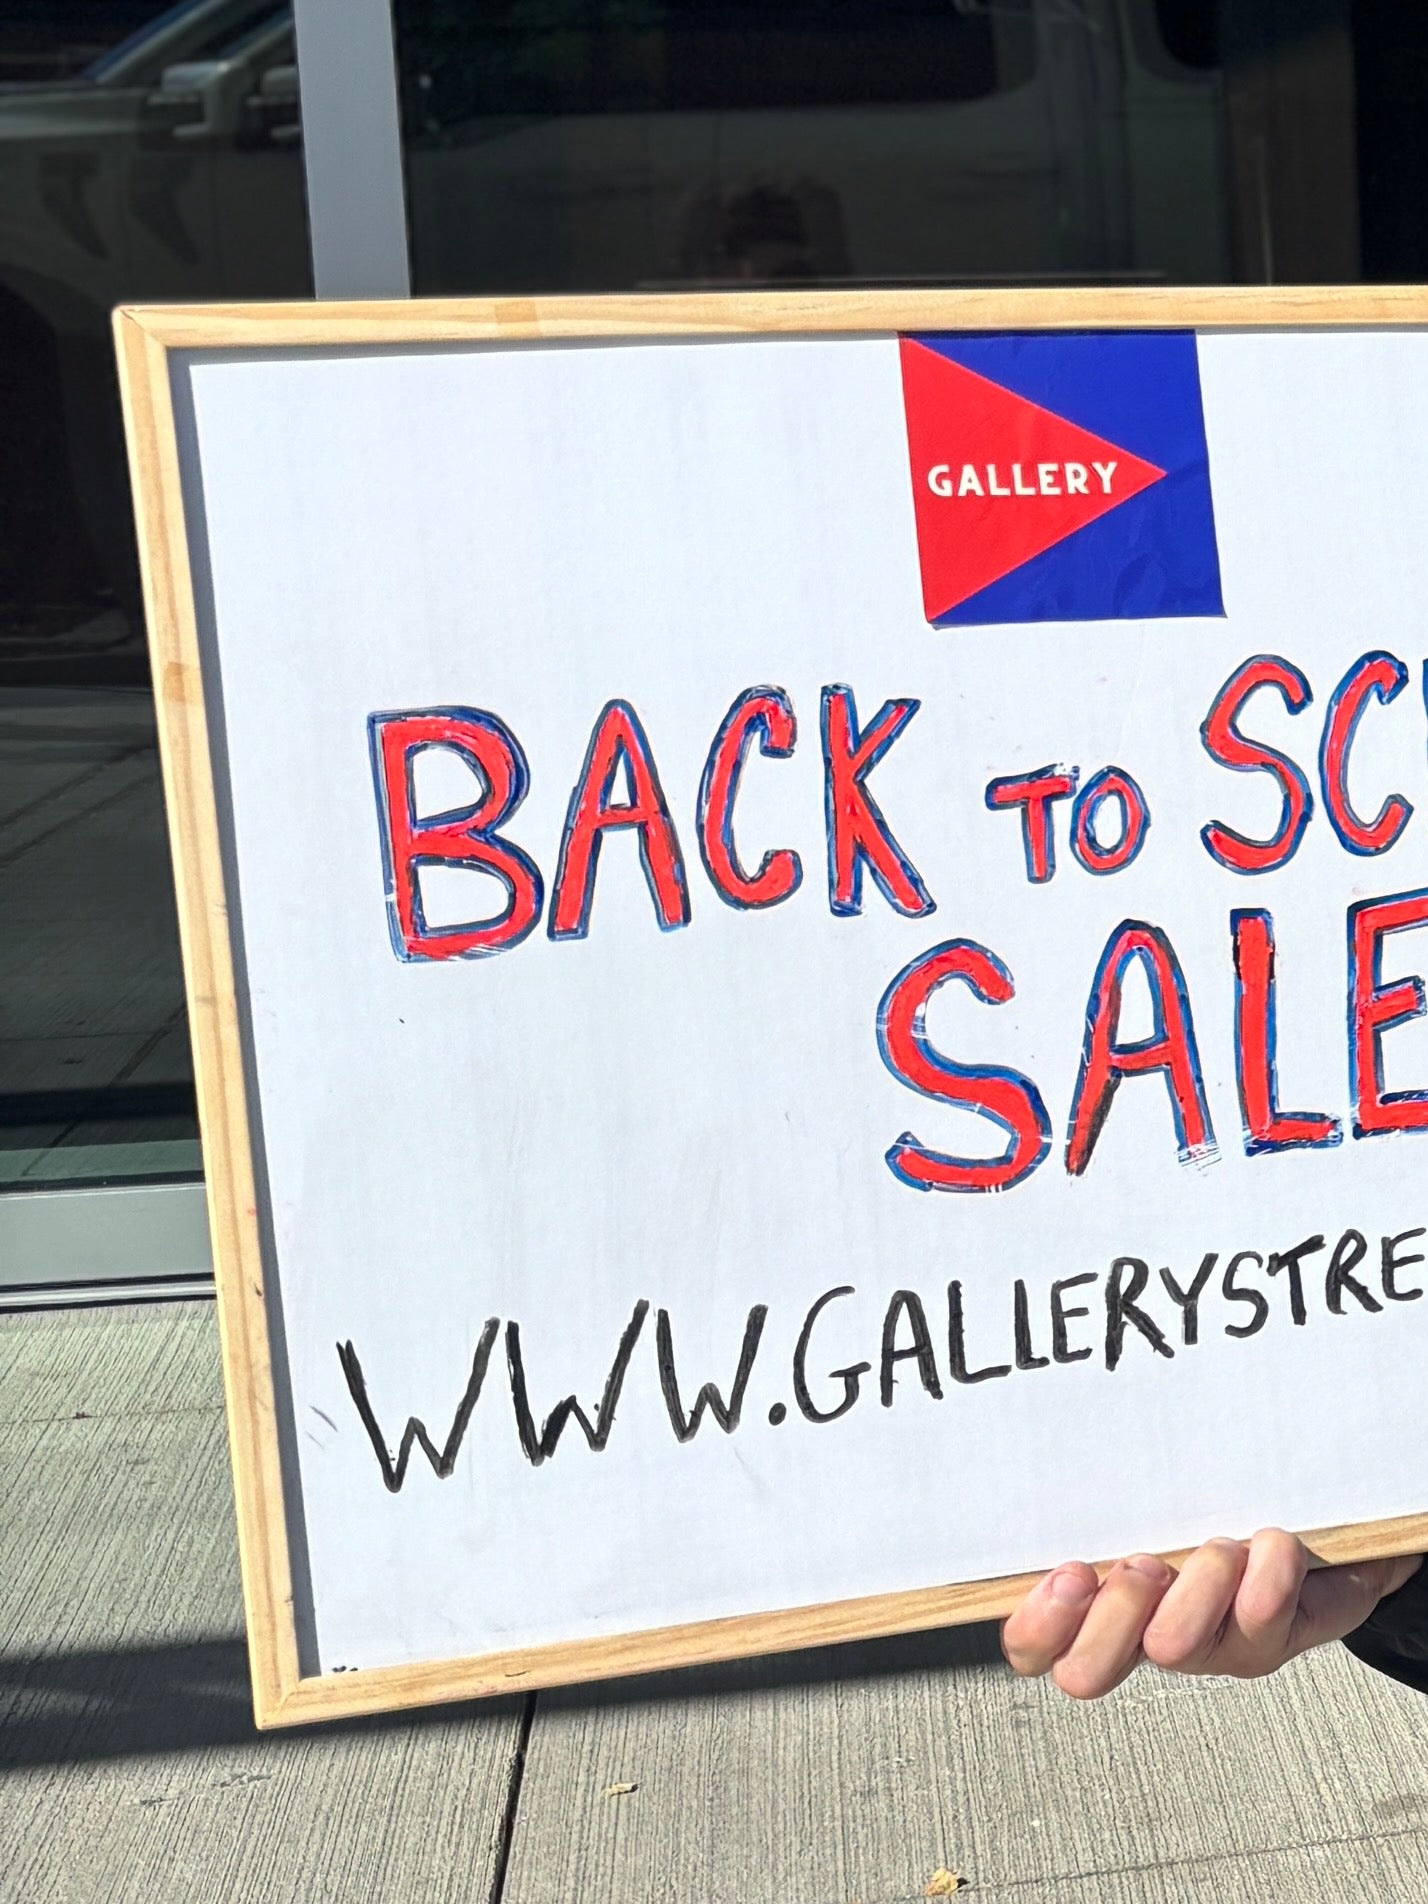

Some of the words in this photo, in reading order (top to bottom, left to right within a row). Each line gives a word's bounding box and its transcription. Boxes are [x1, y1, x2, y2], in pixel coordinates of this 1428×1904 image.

[927, 462, 1118, 497] GALLERY
[368, 684, 937, 963] BACK
[985, 764, 1151, 884] TO
